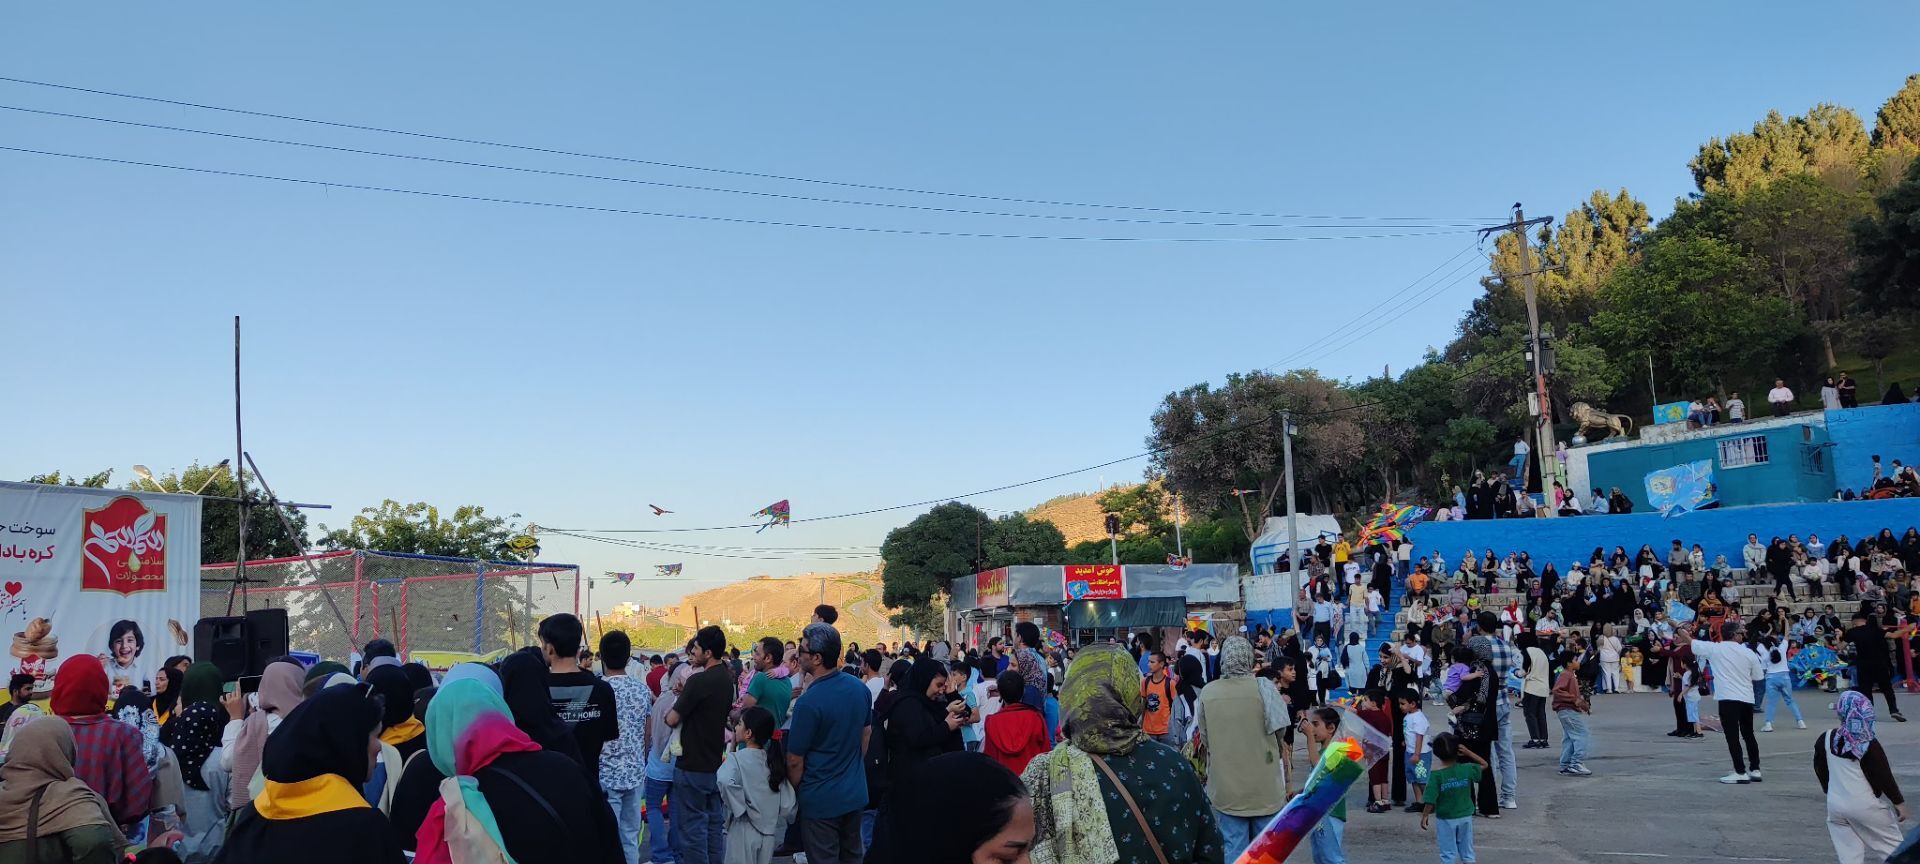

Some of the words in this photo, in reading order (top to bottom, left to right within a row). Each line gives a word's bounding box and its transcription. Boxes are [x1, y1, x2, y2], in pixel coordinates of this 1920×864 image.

[9, 521, 56, 539] سوخت
[0, 544, 26, 563] بادا
[29, 545, 55, 563] کره
[115, 571, 164, 584] محصولات
[1096, 565, 1115, 576] خوش
[578, 709, 601, 720] HOMES
